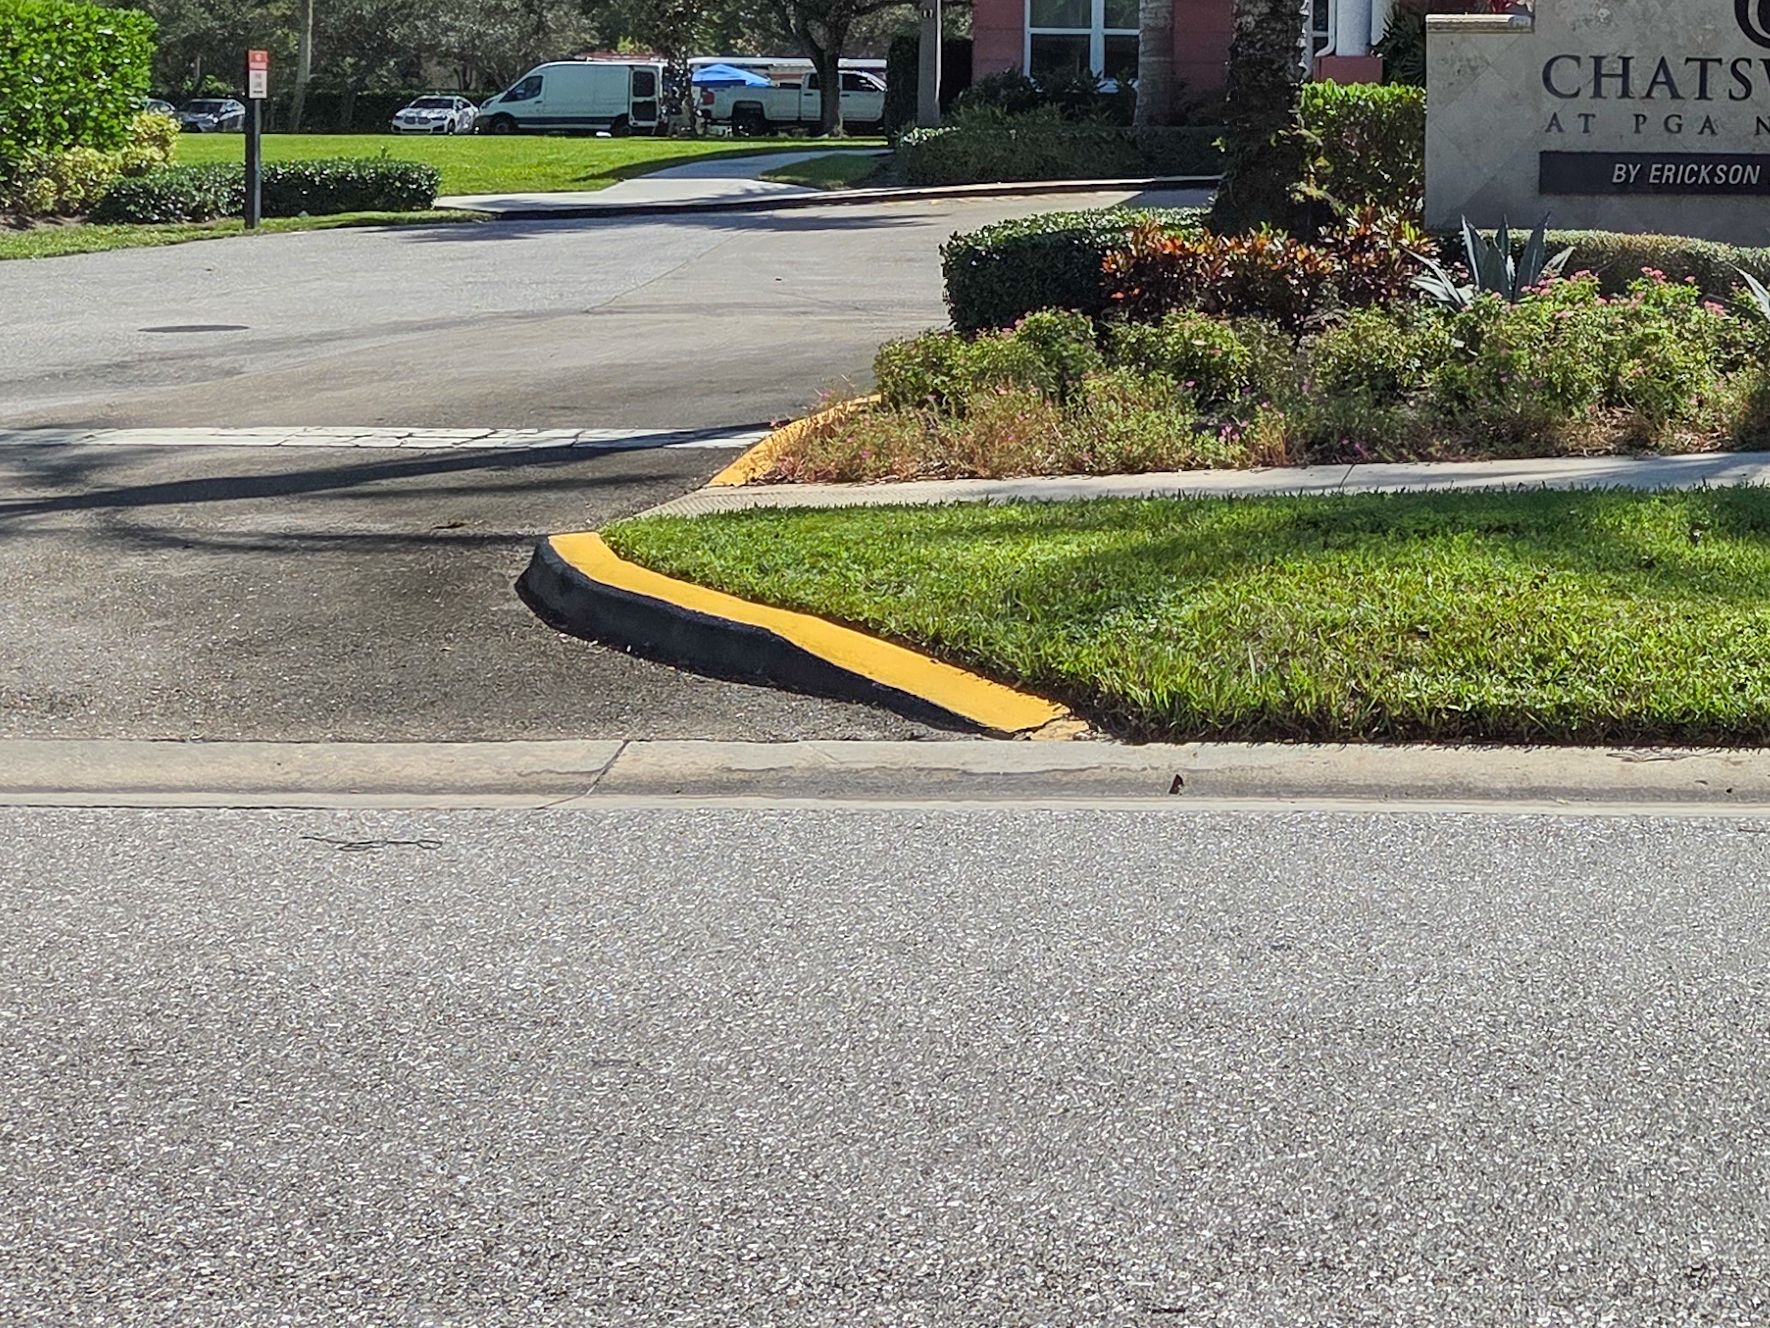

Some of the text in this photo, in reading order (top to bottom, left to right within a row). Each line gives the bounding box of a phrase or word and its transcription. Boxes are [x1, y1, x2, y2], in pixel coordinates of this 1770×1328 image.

[1544, 112, 1596, 134] AT
[1633, 114, 1718, 136] PGA
[1611, 163, 1641, 184] BY
[1648, 163, 1761, 185] ERICKSON
